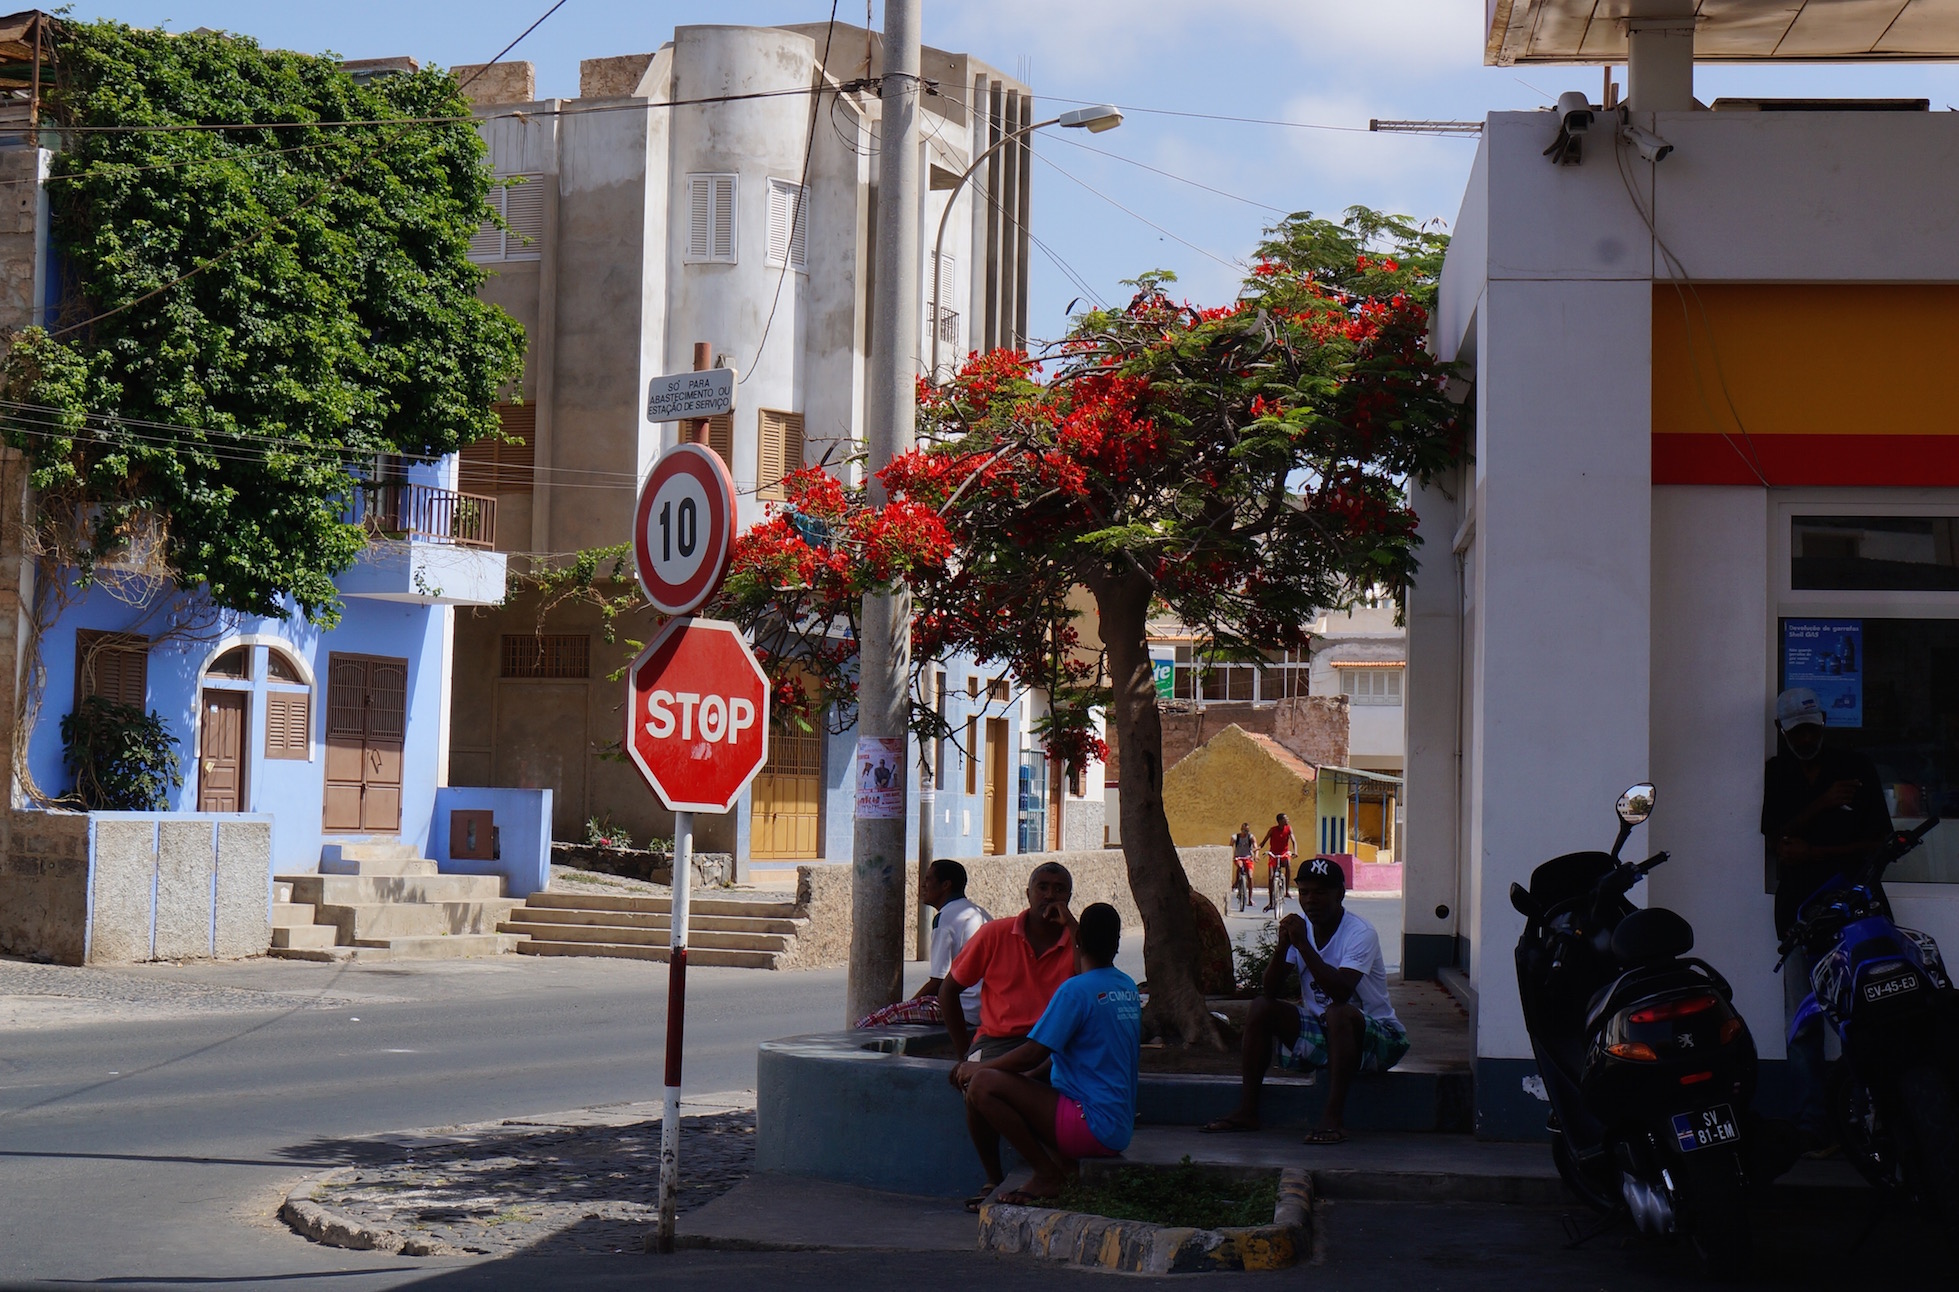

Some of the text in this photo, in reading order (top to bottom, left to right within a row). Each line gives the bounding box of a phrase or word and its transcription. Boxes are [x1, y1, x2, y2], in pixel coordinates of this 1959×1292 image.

[688, 379, 710, 389] PARA
[649, 386, 731, 405] ABASTECIMENTO OU
[648, 397, 730, 416] ESTAÇÃO DE SERVIÇO
[659, 497, 697, 562] 10
[1153, 664, 1171, 681] te
[645, 689, 755, 745] STOP
[1310, 859, 1329, 875] NY
[1702, 1110, 1718, 1127] SV
[1697, 1123, 1736, 1144] 81-EM
